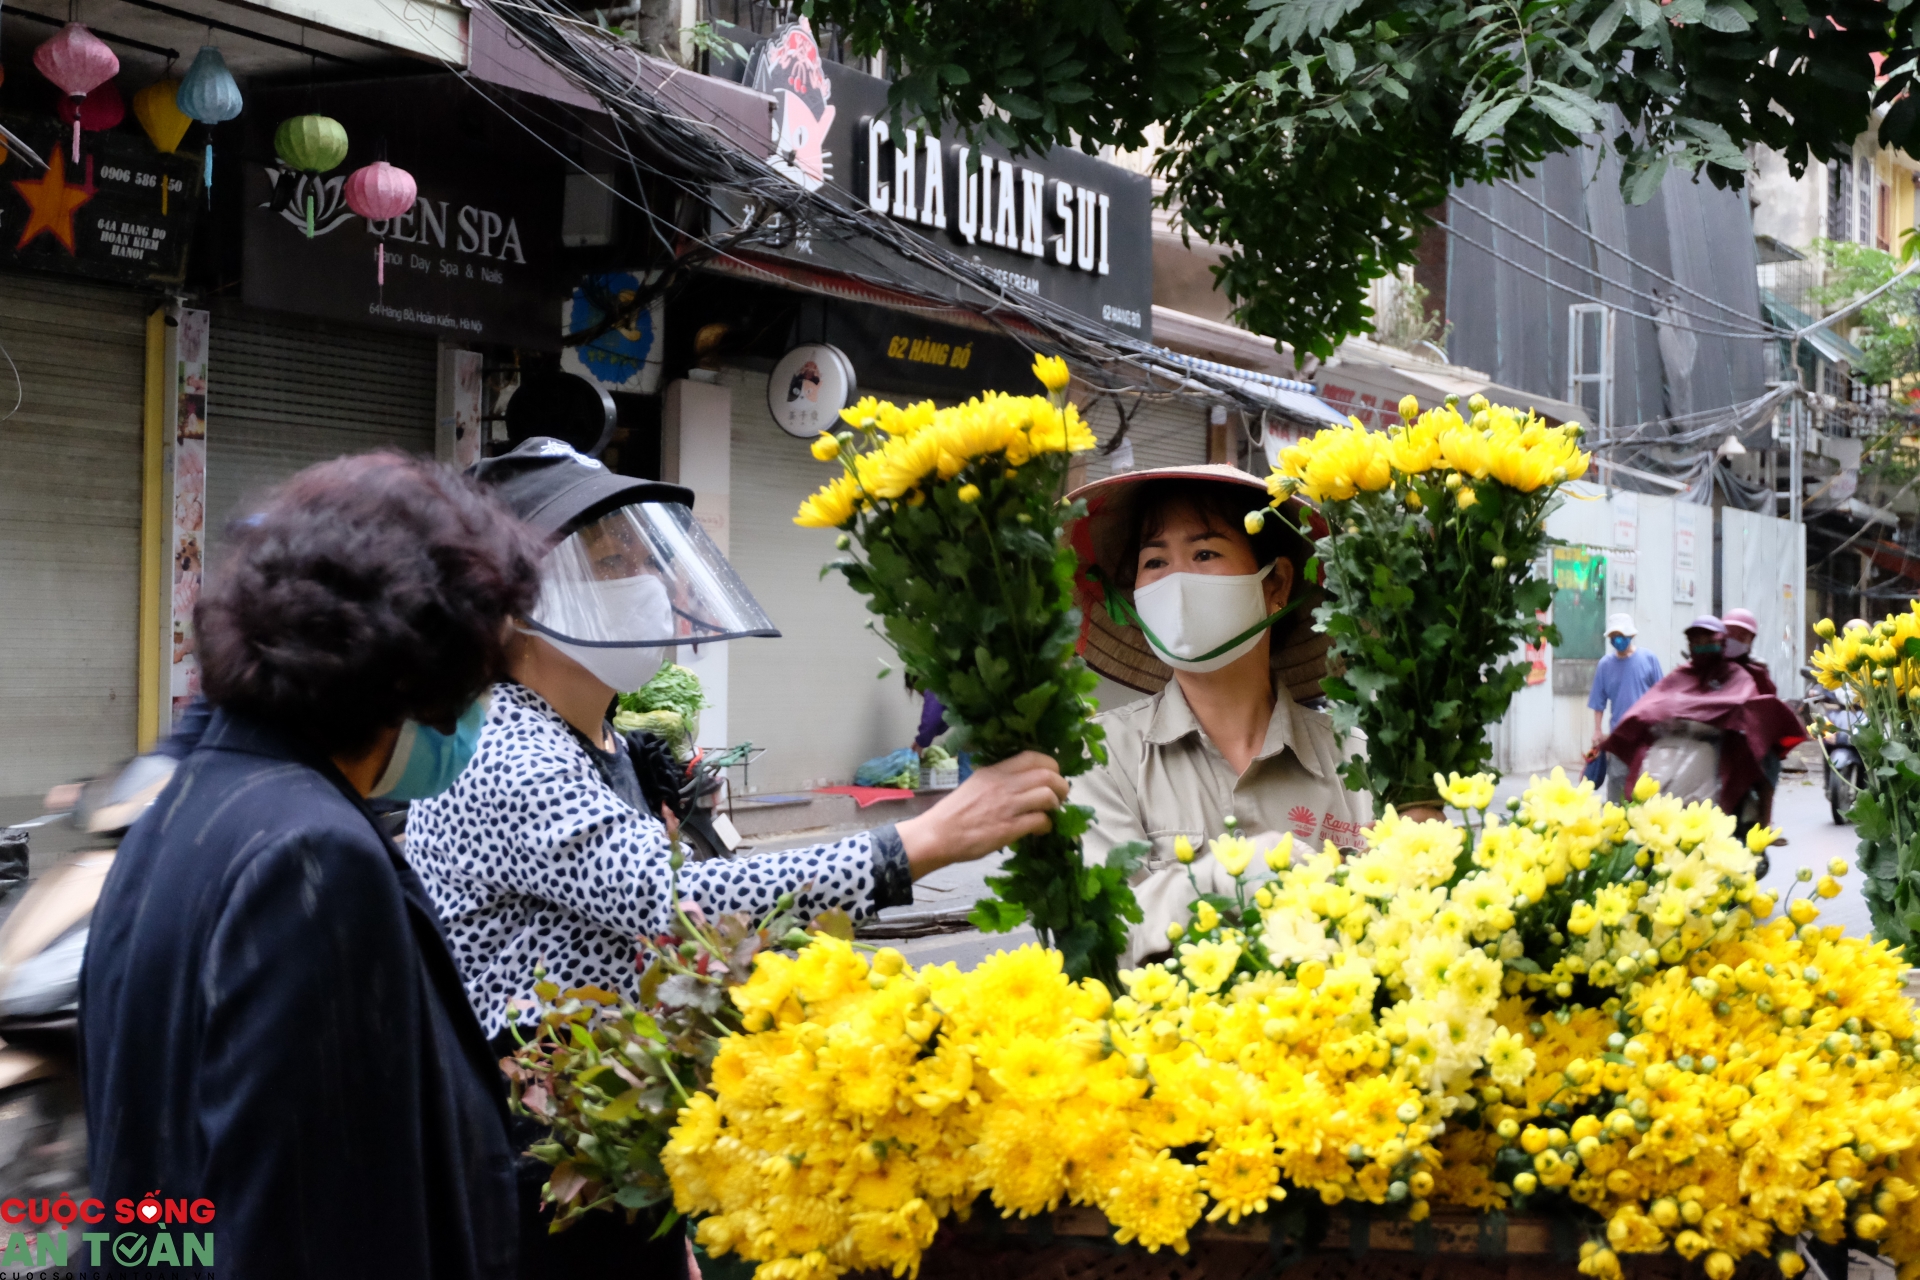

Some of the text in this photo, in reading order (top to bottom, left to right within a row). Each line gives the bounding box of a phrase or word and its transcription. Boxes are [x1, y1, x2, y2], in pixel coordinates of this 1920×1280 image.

[100, 165, 183, 192] 0906 586 50
[869, 118, 947, 229] CHA
[958, 145, 1045, 258] QIAN
[1055, 180, 1110, 276] SUI
[97, 218, 167, 240] 64A HANG BO
[100, 230, 160, 251] HOAN KIEM
[457, 205, 527, 264] SPA
[111, 244, 145, 260] HANOI
[410, 253, 431, 274] Day
[440, 259, 459, 278] Spa
[465, 263, 474, 279] &
[481, 266, 504, 285] Nails
[369, 303, 380, 315] 64
[887, 335, 909, 359] 62
